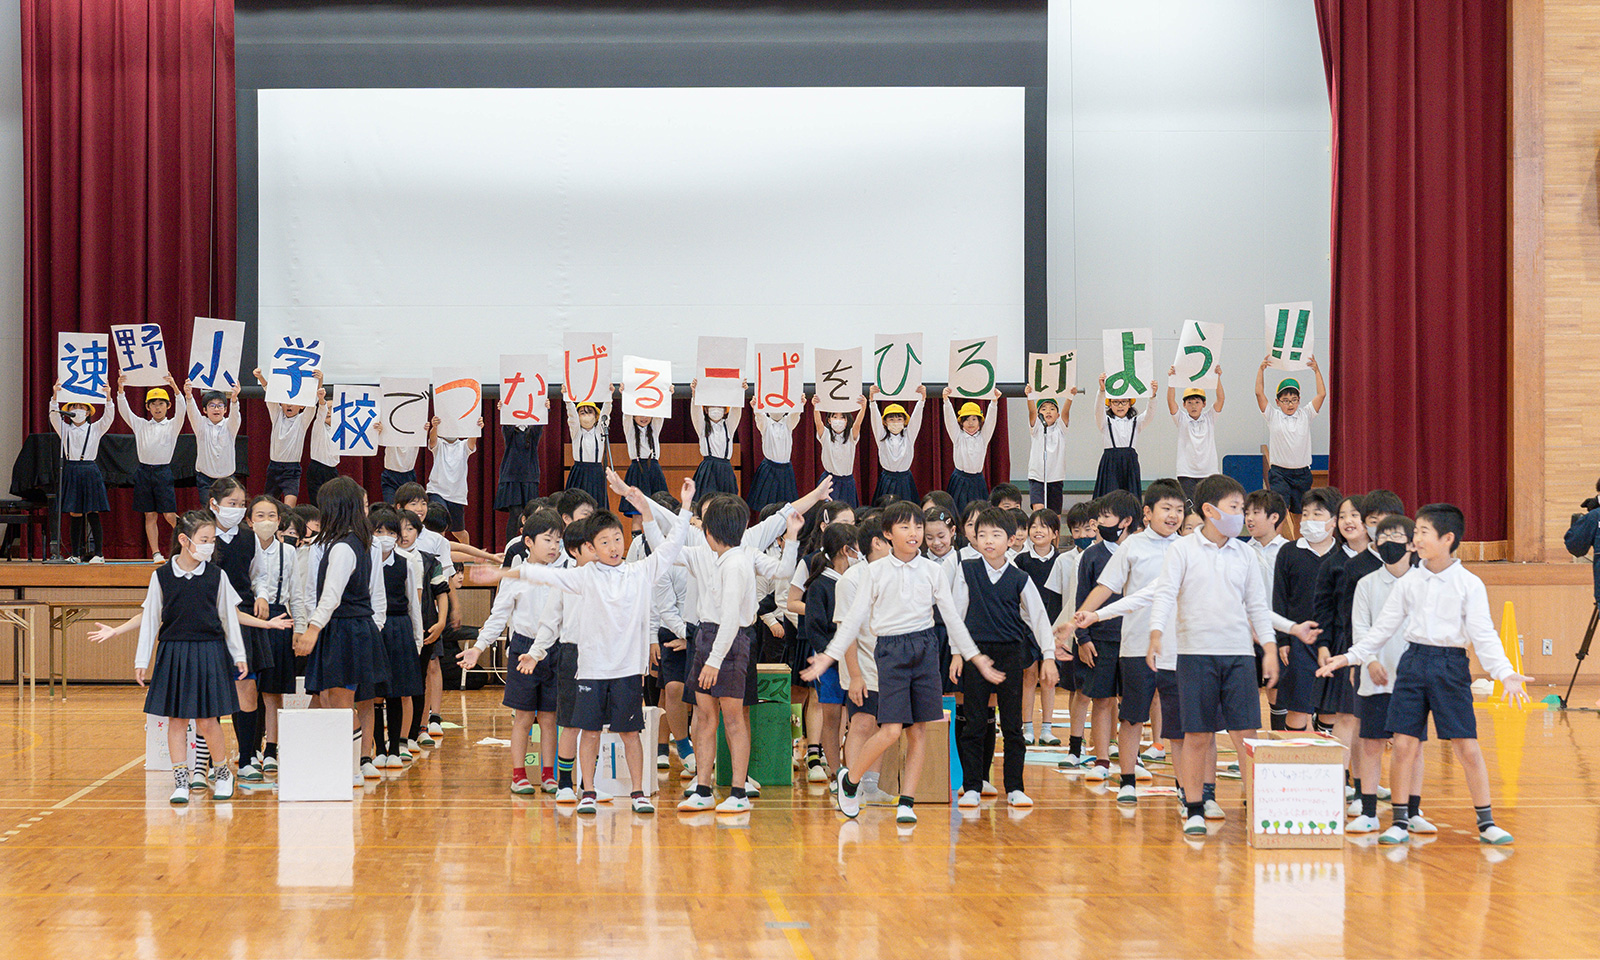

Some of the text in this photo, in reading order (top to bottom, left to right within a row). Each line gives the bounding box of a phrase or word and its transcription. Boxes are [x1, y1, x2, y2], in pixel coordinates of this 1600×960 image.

[61, 340, 108, 398] 速
[114, 325, 163, 371] 野
[188, 330, 235, 387] 小
[273, 336, 321, 399] 学
[564, 343, 608, 401] げ
[874, 342, 922, 397] ひ
[957, 341, 995, 396] ろ
[1034, 351, 1073, 394] げ
[1105, 332, 1147, 396] よ
[1184, 322, 1213, 382] う
[435, 378, 481, 420] つ
[504, 372, 545, 422] な
[634, 368, 663, 408] る
[757, 351, 799, 409] ぱ
[822, 359, 852, 400] を
[332, 392, 376, 450] 校
[384, 391, 429, 434] で
